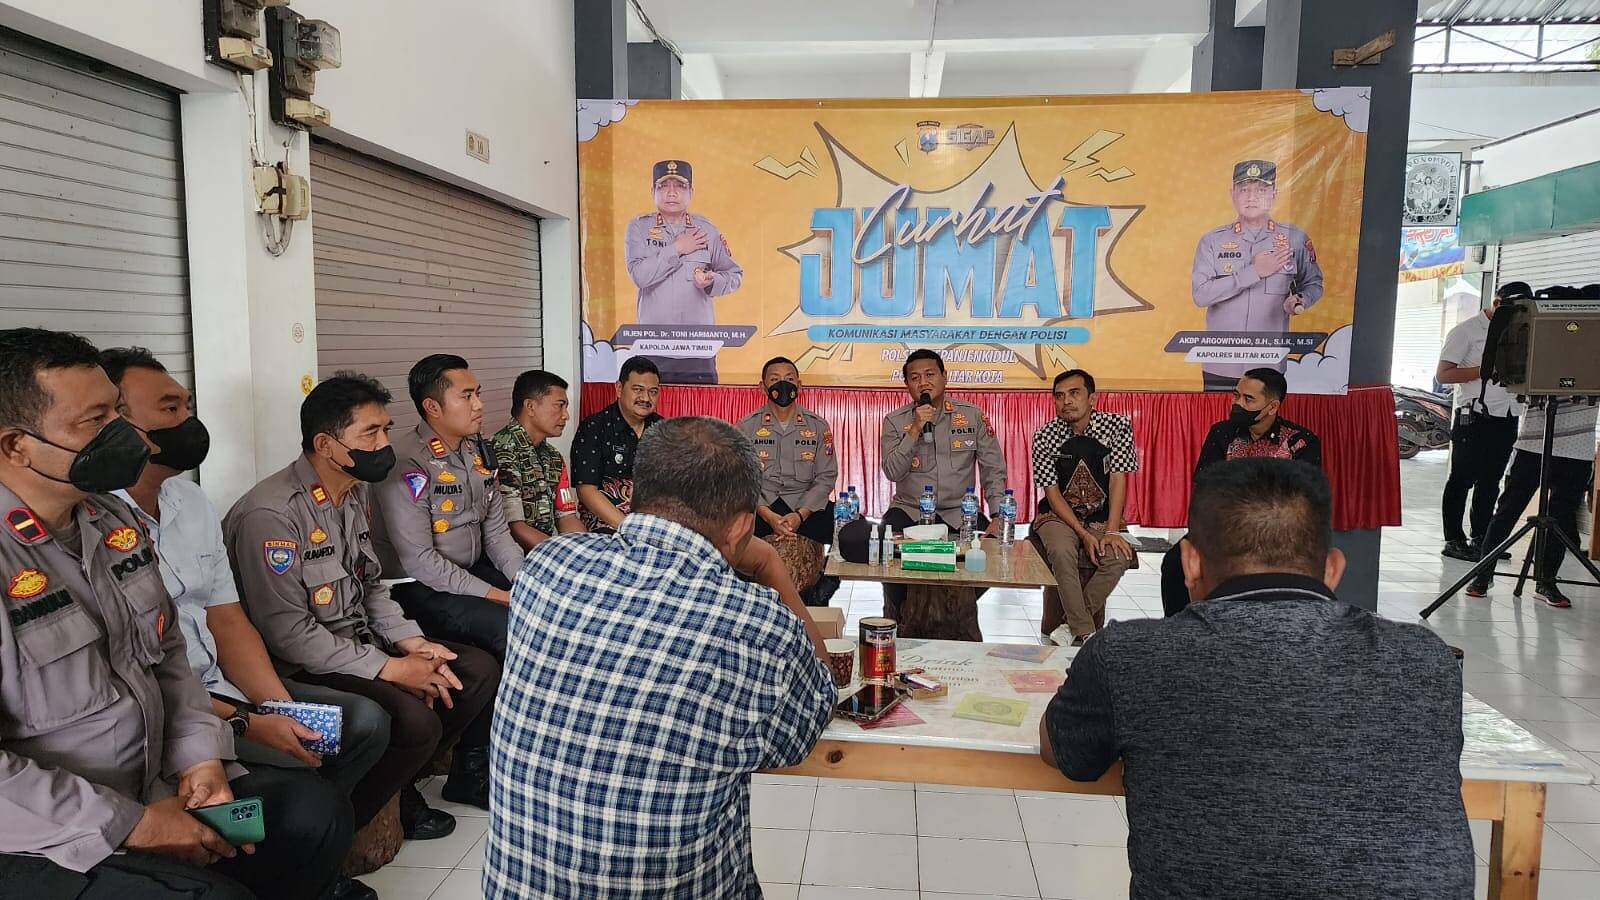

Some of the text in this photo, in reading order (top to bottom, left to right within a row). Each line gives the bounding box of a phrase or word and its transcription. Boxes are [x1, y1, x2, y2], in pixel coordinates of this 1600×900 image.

[852, 176, 1066, 265] Curhat
[800, 206, 1113, 318] JUMAT
[828, 329, 1068, 340] KOMUNIKASI MASYARAKAT DENGAN POLISI
[1201, 337, 1254, 345] ARGOWIYONO,
[975, 370, 1004, 384] KOTA
